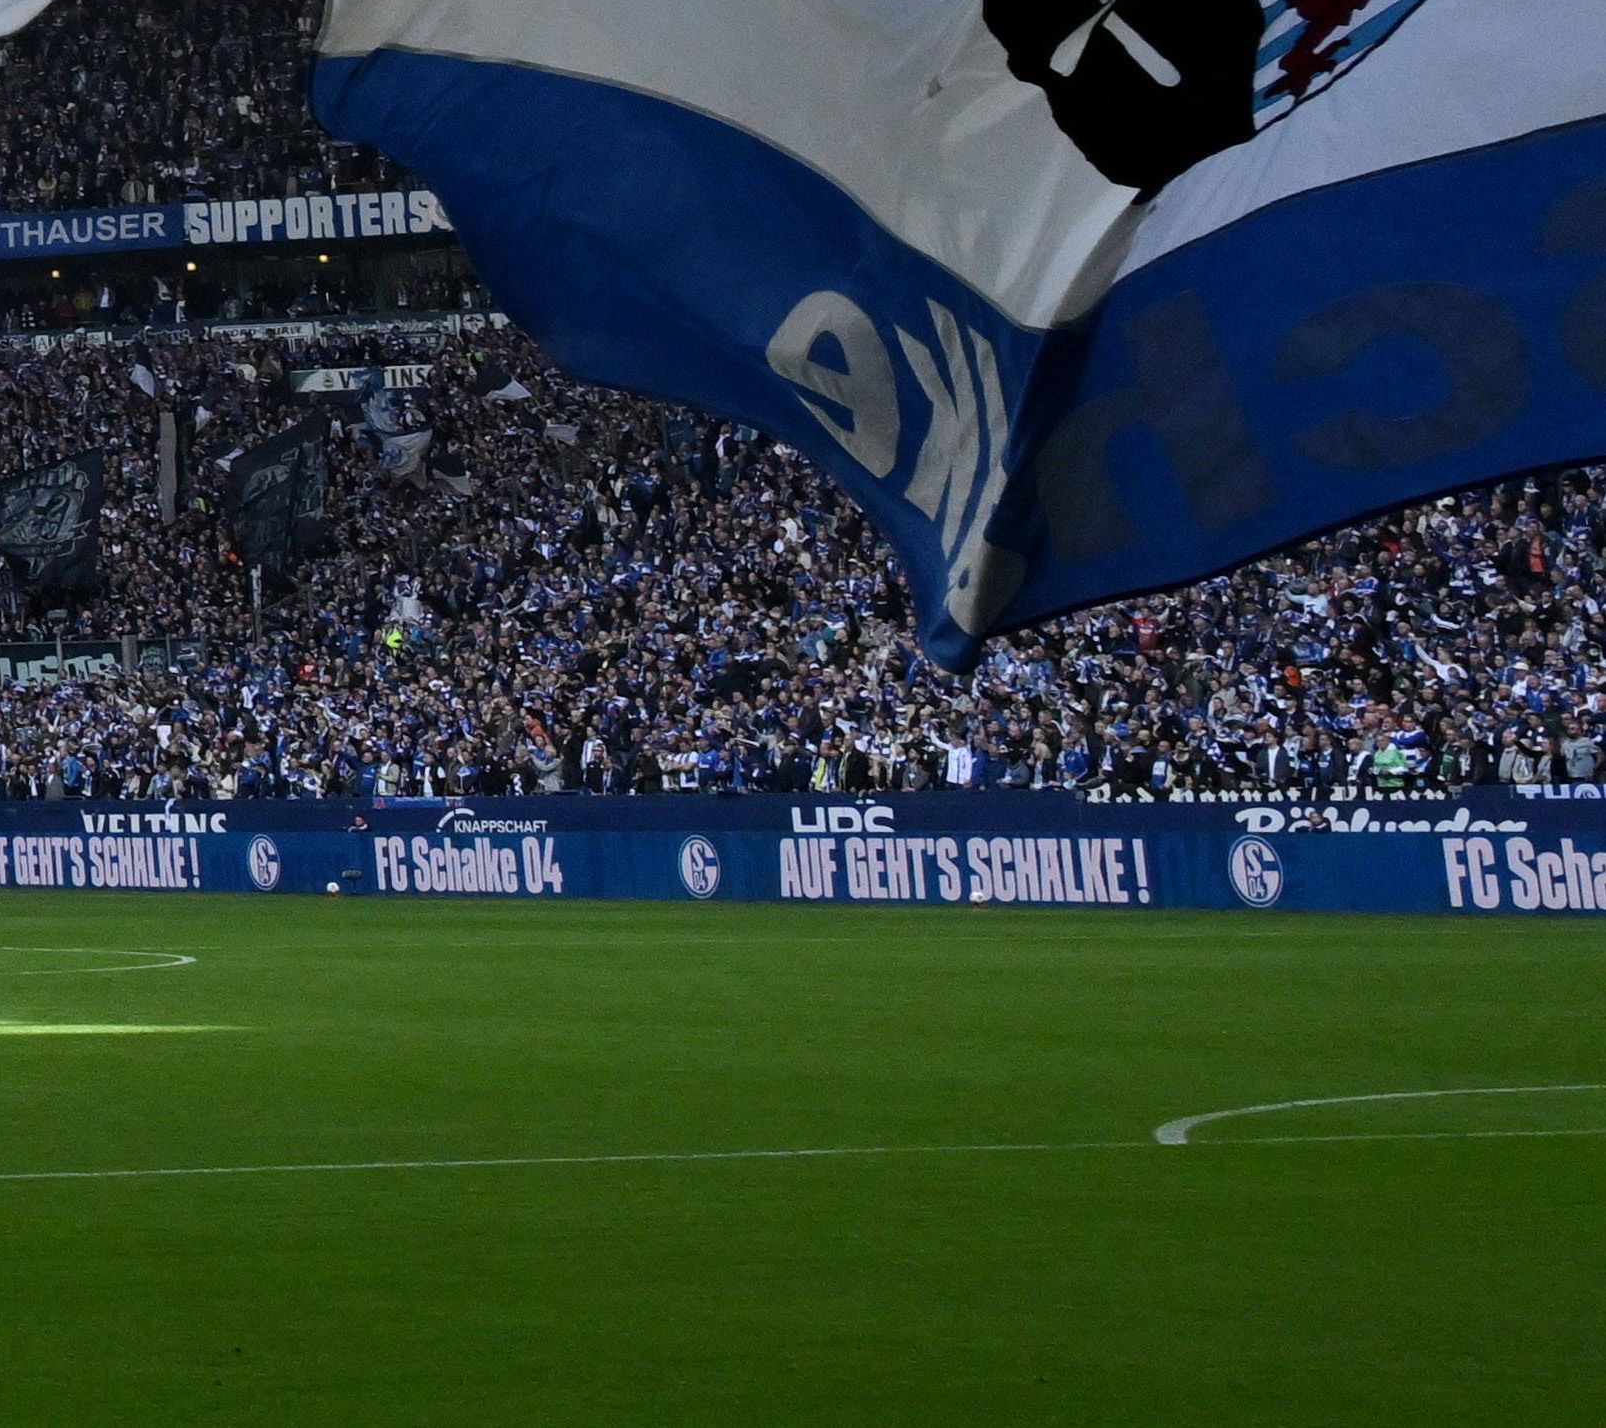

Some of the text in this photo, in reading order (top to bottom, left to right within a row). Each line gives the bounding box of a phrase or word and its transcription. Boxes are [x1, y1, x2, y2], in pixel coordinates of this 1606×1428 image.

[186, 190, 434, 245] SUPPORTERS
[339, 367, 429, 389] VINS
[454, 819, 548, 833] KNAPPSCHAFT
[13, 836, 86, 887] GEHT'S
[89, 836, 188, 888] SCHALKE
[373, 835, 564, 894] FC Schalke 04
[779, 836, 838, 899] AUF
[844, 836, 962, 902] GEHT'S
[967, 836, 1129, 906] SCHALKE
[1441, 836, 1501, 910] FC
